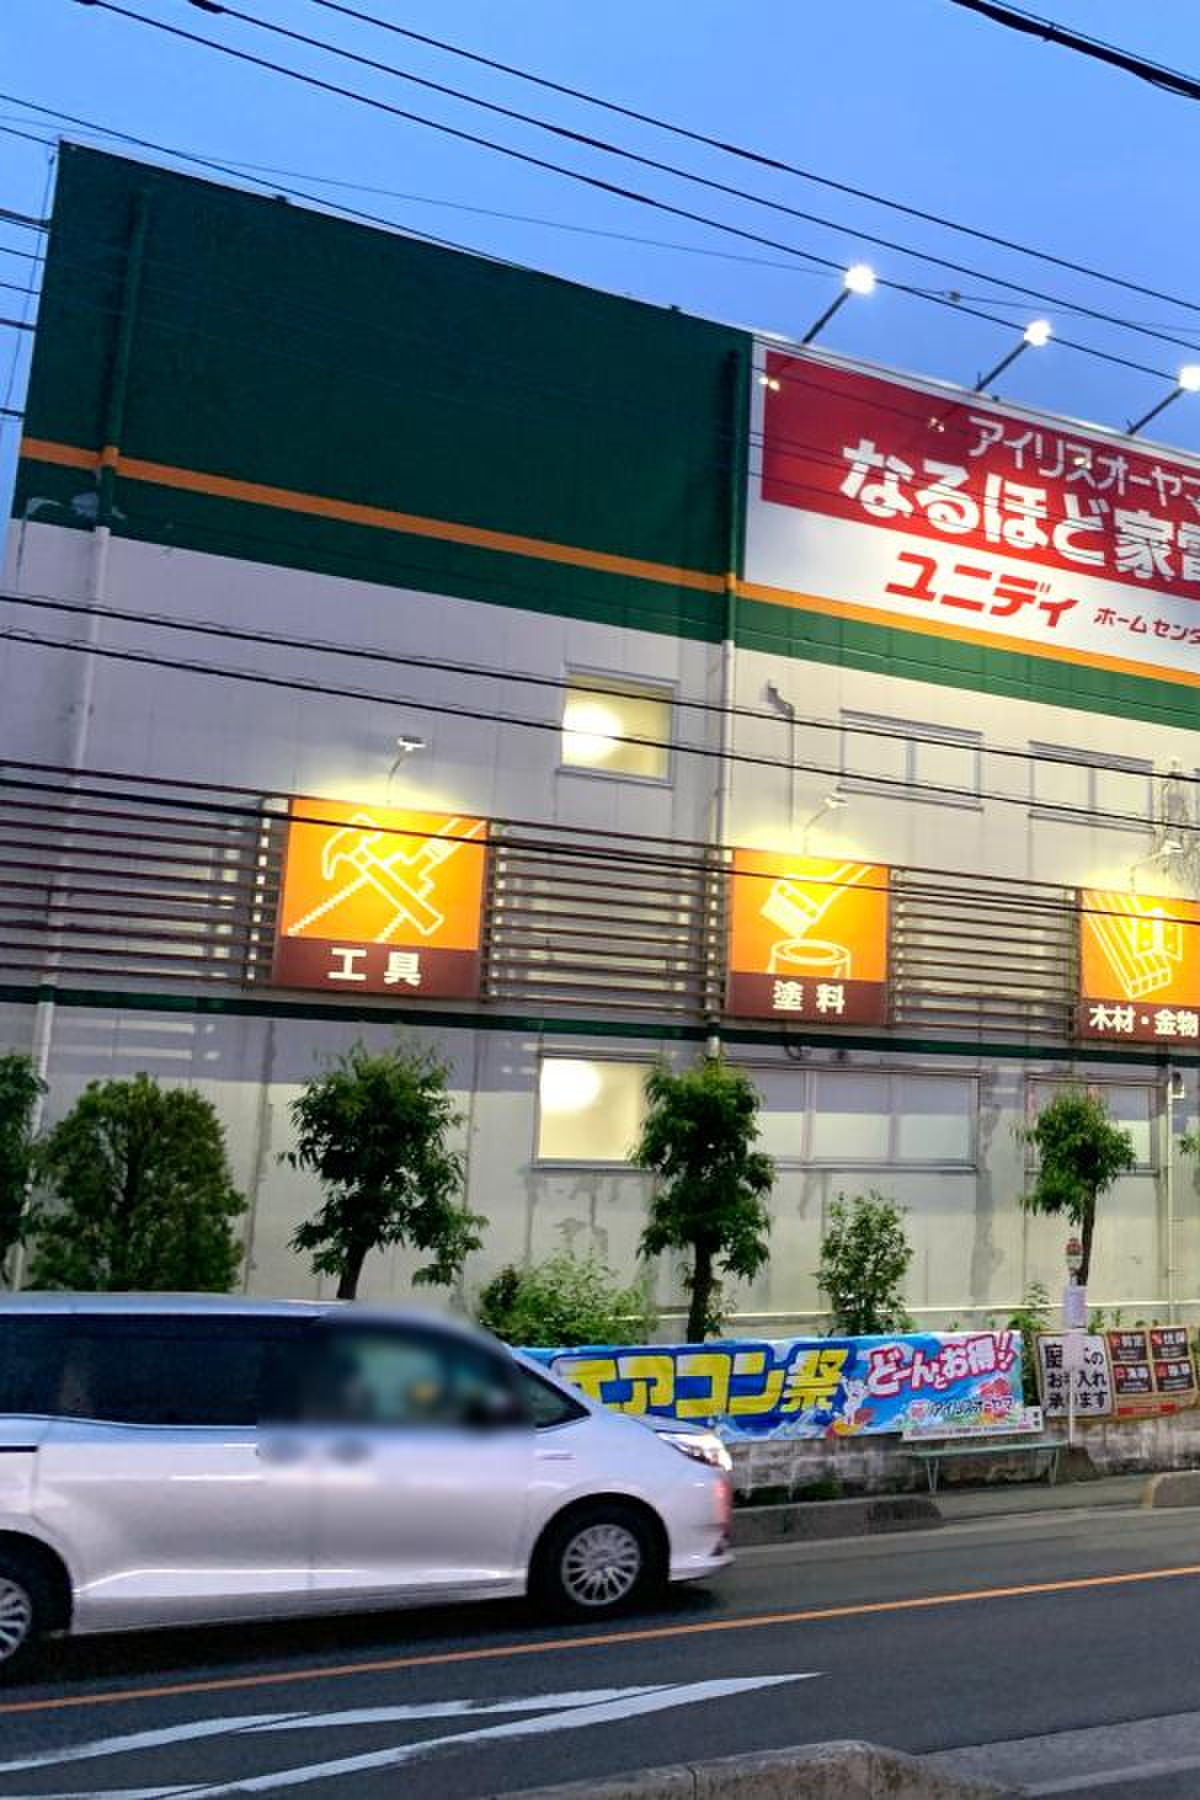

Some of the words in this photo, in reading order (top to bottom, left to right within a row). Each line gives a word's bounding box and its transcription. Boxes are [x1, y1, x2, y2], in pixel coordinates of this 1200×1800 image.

[885, 551, 1079, 628] ユニディ
[327, 947, 422, 987] 工具
[772, 980, 845, 1014] 塗料
[1089, 1003, 1199, 1038] 木材・金物
[1044, 1343, 1105, 1368] 庭の
